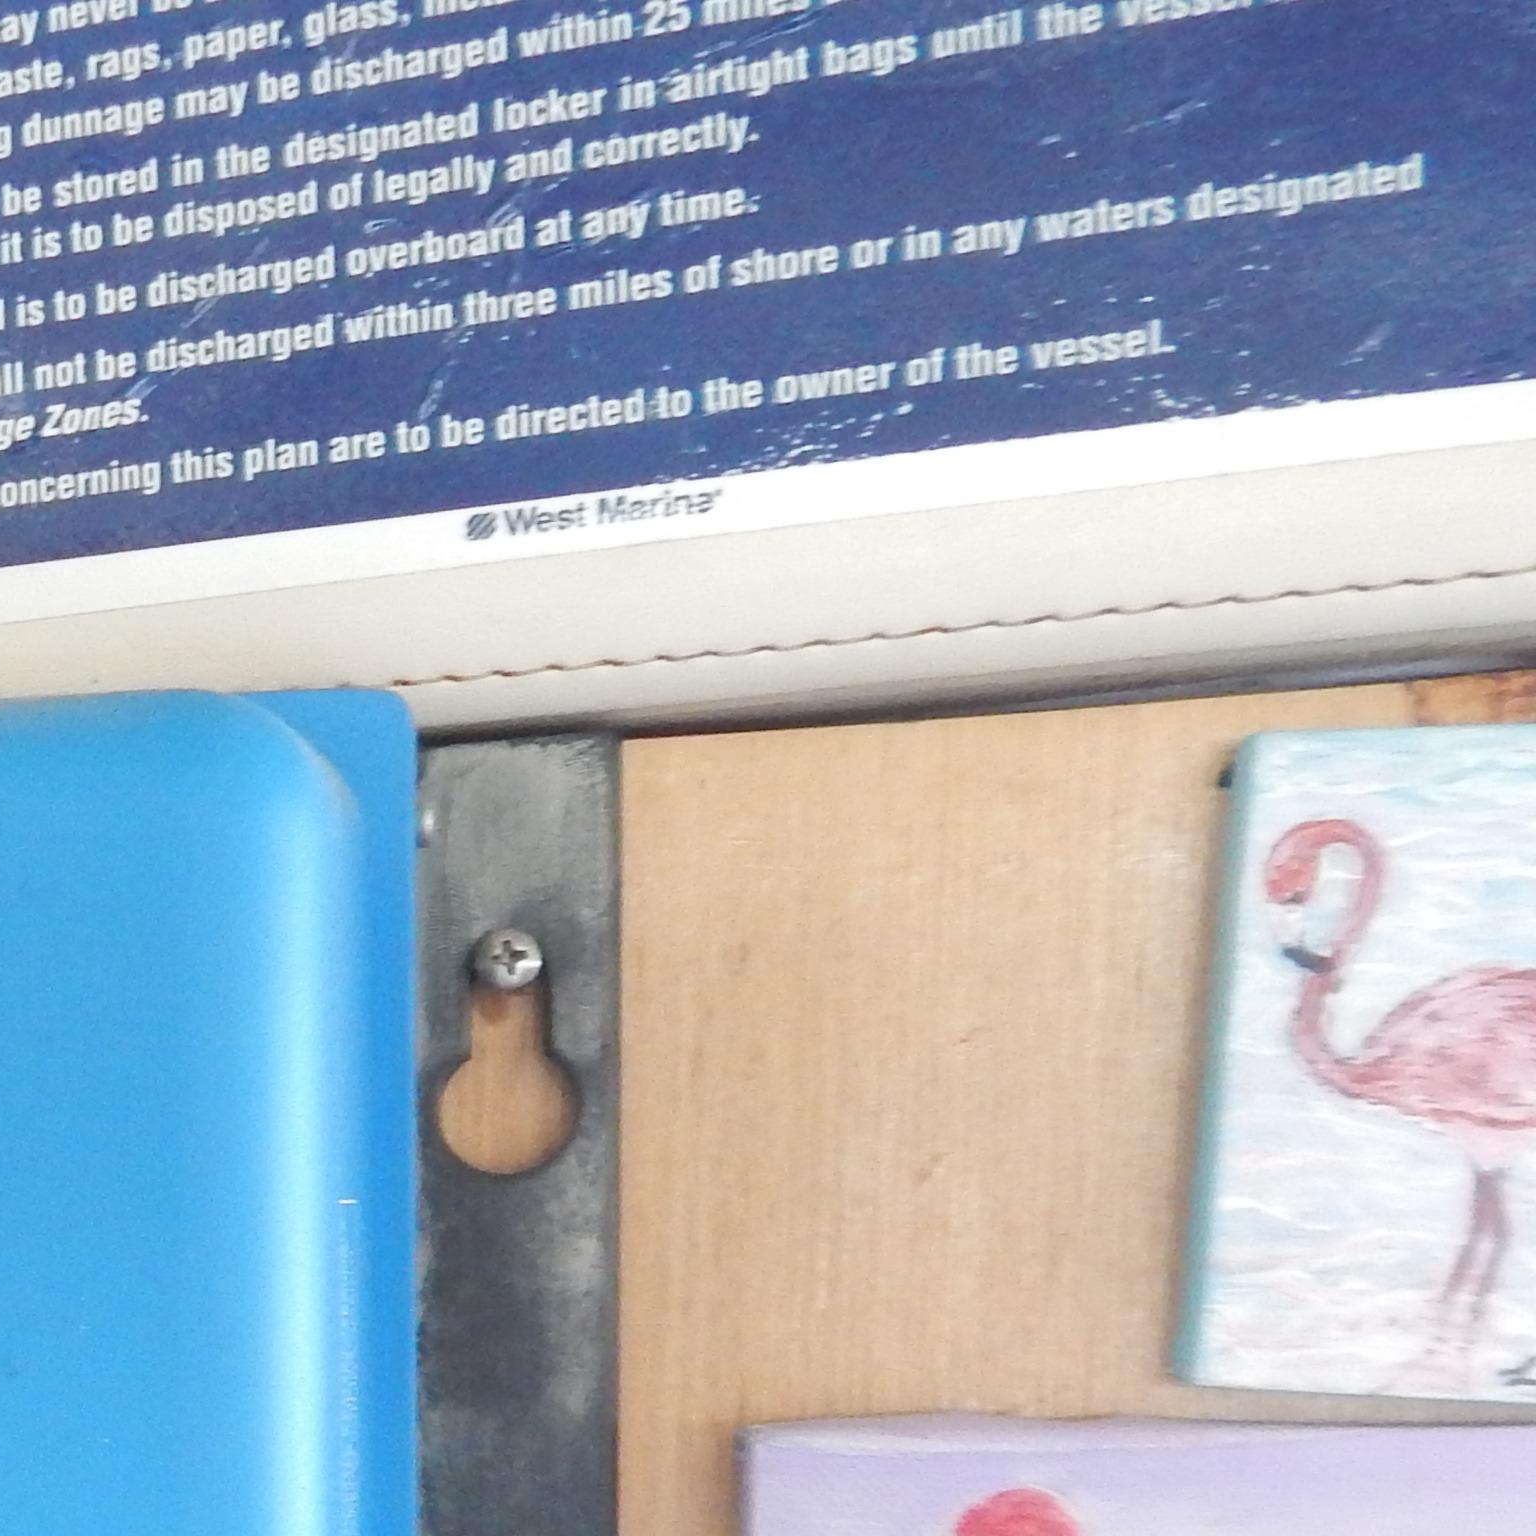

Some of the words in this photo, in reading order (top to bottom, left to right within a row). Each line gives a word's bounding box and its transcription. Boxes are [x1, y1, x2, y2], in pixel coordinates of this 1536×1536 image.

[1, 183, 42, 217] be
[53, 157, 158, 208] stored
[171, 153, 204, 187] in
[215, 143, 271, 180] the
[283, 102, 479, 168] designated
[493, 88, 607, 133] locker
[620, 76, 656, 111] in
[666, 47, 808, 103] airtight
[823, 35, 917, 77] bags
[932, 9, 1022, 59] until
[1037, 2, 1102, 40] the
[1116, 0, 1253, 27] vess
[21, 97, 165, 148] dunnage
[175, 81, 249, 119] may
[257, 71, 300, 104] be
[311, 26, 508, 95] discharged
[518, 9, 633, 58] within
[643, 0, 691, 37] 25
[86, 42, 172, 82] rags,
[183, 20, 291, 69] paper,
[303, 0, 410, 47] glass,
[0, 231, 23, 265] it
[32, 226, 62, 260] is
[69, 221, 103, 254] to
[112, 213, 154, 247] be
[163, 179, 318, 238] disposed
[328, 172, 363, 211] of
[373, 154, 495, 206] legally
[505, 138, 572, 182] and
[582, 112, 759, 169] correctly.
[15, 295, 46, 328] is
[52, 290, 87, 322] to
[95, 282, 137, 316] be
[146, 245, 335, 308] discharged
[345, 213, 525, 278] overboard
[536, 209, 572, 247] at
[582, 199, 650, 244] any
[659, 188, 759, 226] time.
[33, 352, 87, 391] not
[95, 348, 137, 382] be
[146, 313, 334, 373] discharged
[343, 298, 454, 343] within
[462, 287, 558, 329] three
[569, 269, 673, 310] miles
[683, 254, 721, 294] of
[730, 245, 839, 287] shore
[851, 237, 893, 269] or
[904, 225, 941, 261] in
[953, 218, 1026, 256] any
[1036, 196, 1174, 242] waters
[1187, 153, 1425, 221] designated
[39, 397, 149, 438] Zones.
[170, 446, 234, 484] this
[243, 438, 319, 482] plan
[329, 431, 386, 463] are
[395, 421, 431, 454] to
[441, 414, 484, 448] be
[495, 388, 645, 441] directed
[655, 386, 692, 419] to
[703, 377, 763, 415] the
[774, 362, 896, 404] owner
[906, 347, 944, 387] of
[954, 342, 1018, 380] the
[1030, 319, 1175, 370] vessel.
[503, 503, 586, 536] West
